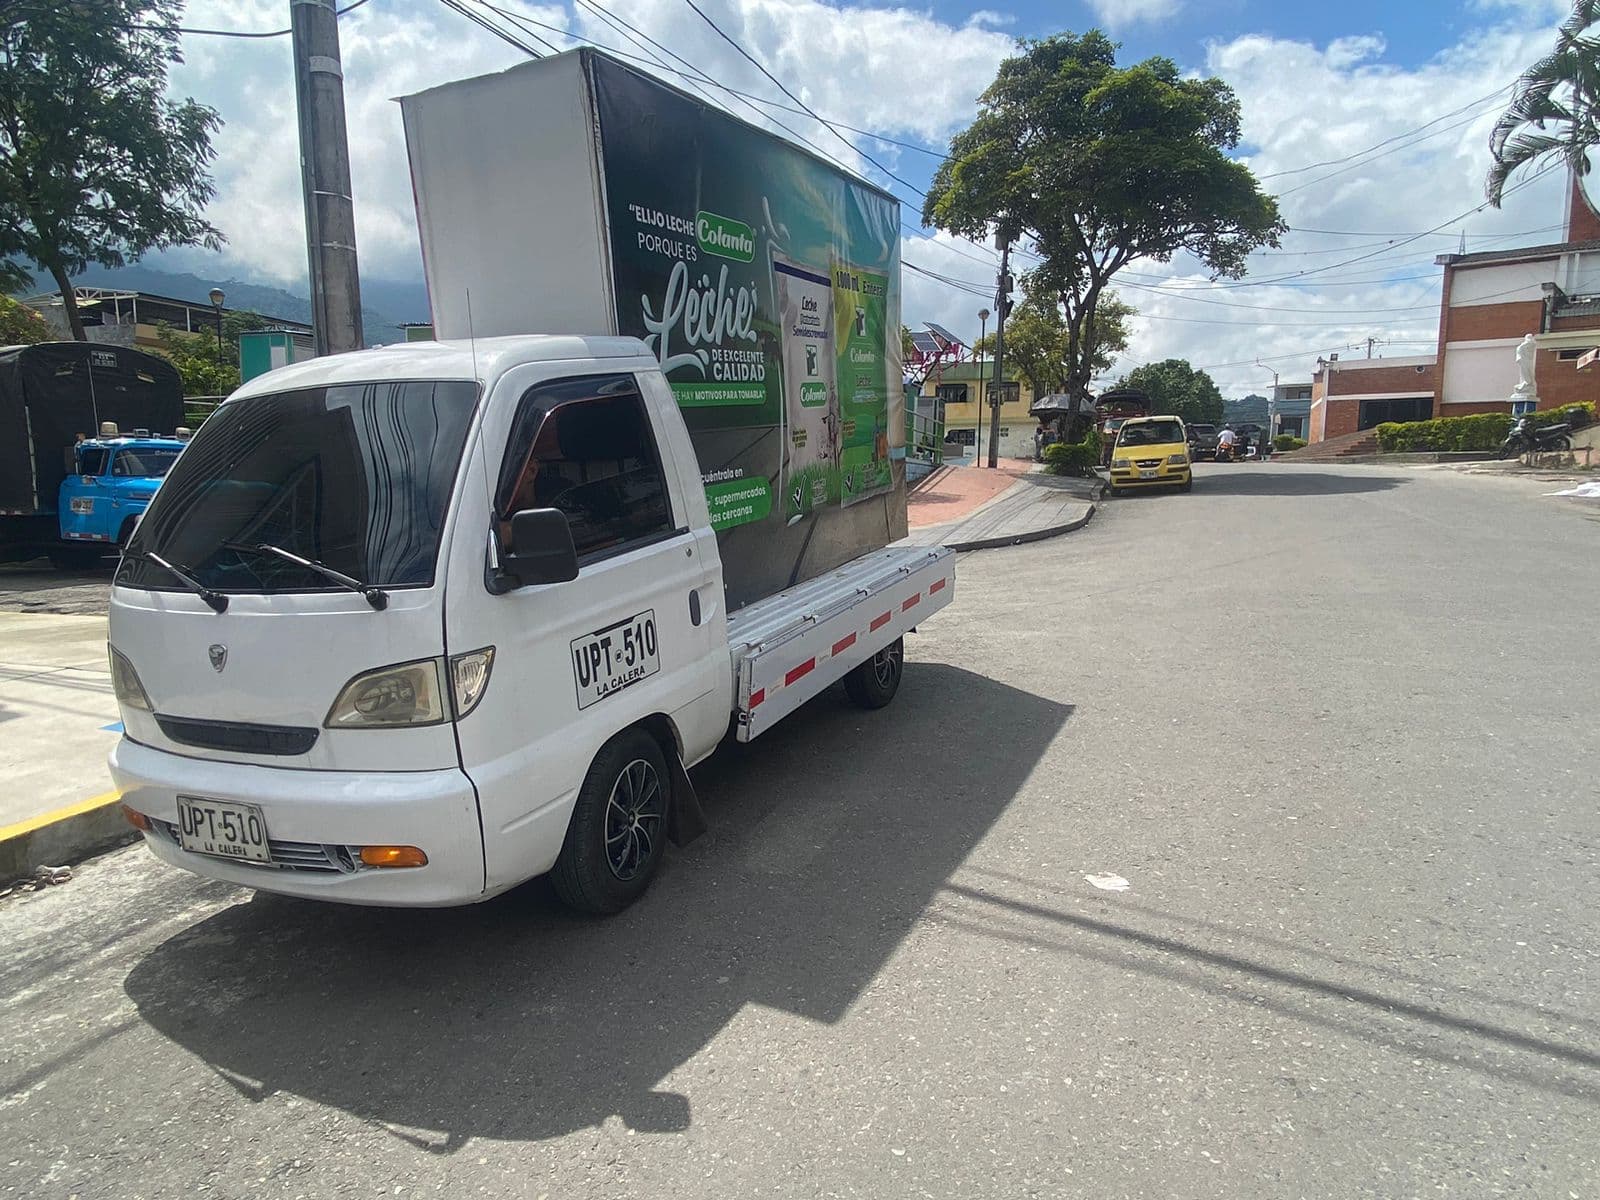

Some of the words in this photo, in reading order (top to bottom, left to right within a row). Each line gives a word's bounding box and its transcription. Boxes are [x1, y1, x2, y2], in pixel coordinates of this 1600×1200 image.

[666, 214, 696, 238] LECHE
[697, 218, 753, 255] Colanta
[638, 232, 684, 259] PORQUE
[686, 244, 698, 262] ES
[641, 260, 757, 381] Leche
[712, 348, 723, 362] DE
[724, 349, 765, 364] EXCELENTE
[850, 347, 875, 363] Colanta
[713, 362, 766, 382] CALIDAD
[694, 391, 723, 401] MOTIVOS
[723, 390, 738, 400] PARA
[800, 386, 827, 403] Colanta
[734, 468, 744, 478] en
[714, 485, 767, 507] supermercados
[575, 636, 612, 688] UPT
[623, 619, 656, 667] 510
[597, 683, 609, 696] LA
[611, 665, 646, 689] CALERA
[180, 804, 216, 840] UPT
[222, 810, 262, 846] 510
[204, 841, 214, 852] LA
[218, 843, 248, 857] CALERA
